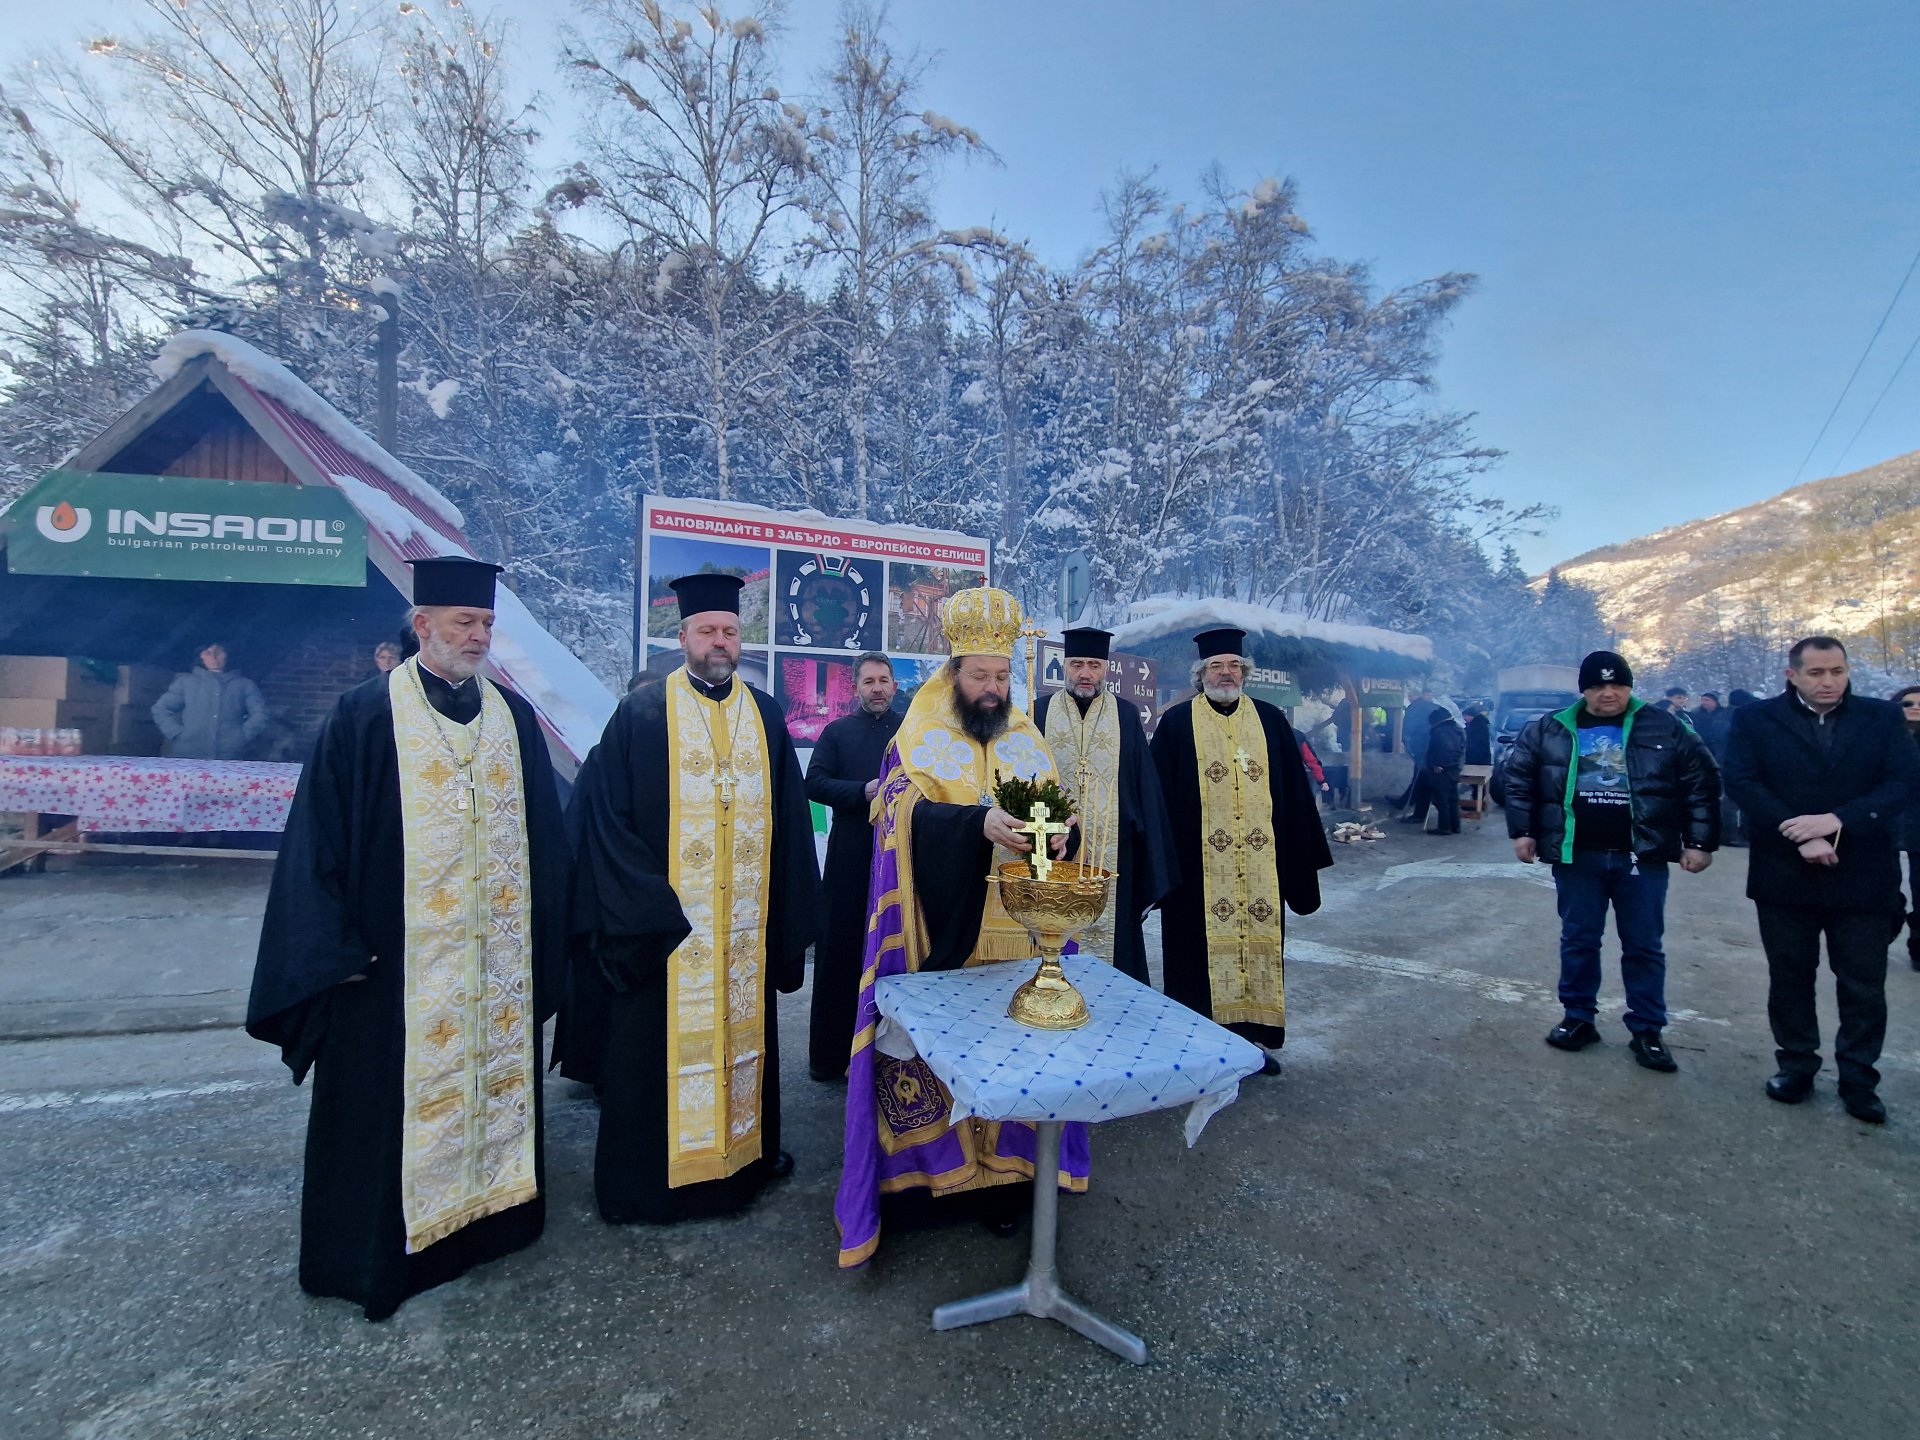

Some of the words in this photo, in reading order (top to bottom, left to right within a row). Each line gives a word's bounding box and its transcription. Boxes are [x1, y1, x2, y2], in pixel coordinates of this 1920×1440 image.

[108, 537, 183, 549] bulgarian
[191, 541, 268, 553] petroleum
[276, 545, 342, 557] company
[655, 514, 761, 537] ЗАПОВЯДАЙТЕ
[764, 528, 775, 538] В
[777, 530, 841, 546] ЗАБЪРДО
[851, 538, 931, 556] ЕВРОПЕЙСКО
[933, 549, 982, 562] СЕЛИЩЕ
[1105, 678, 1121, 694] rad
